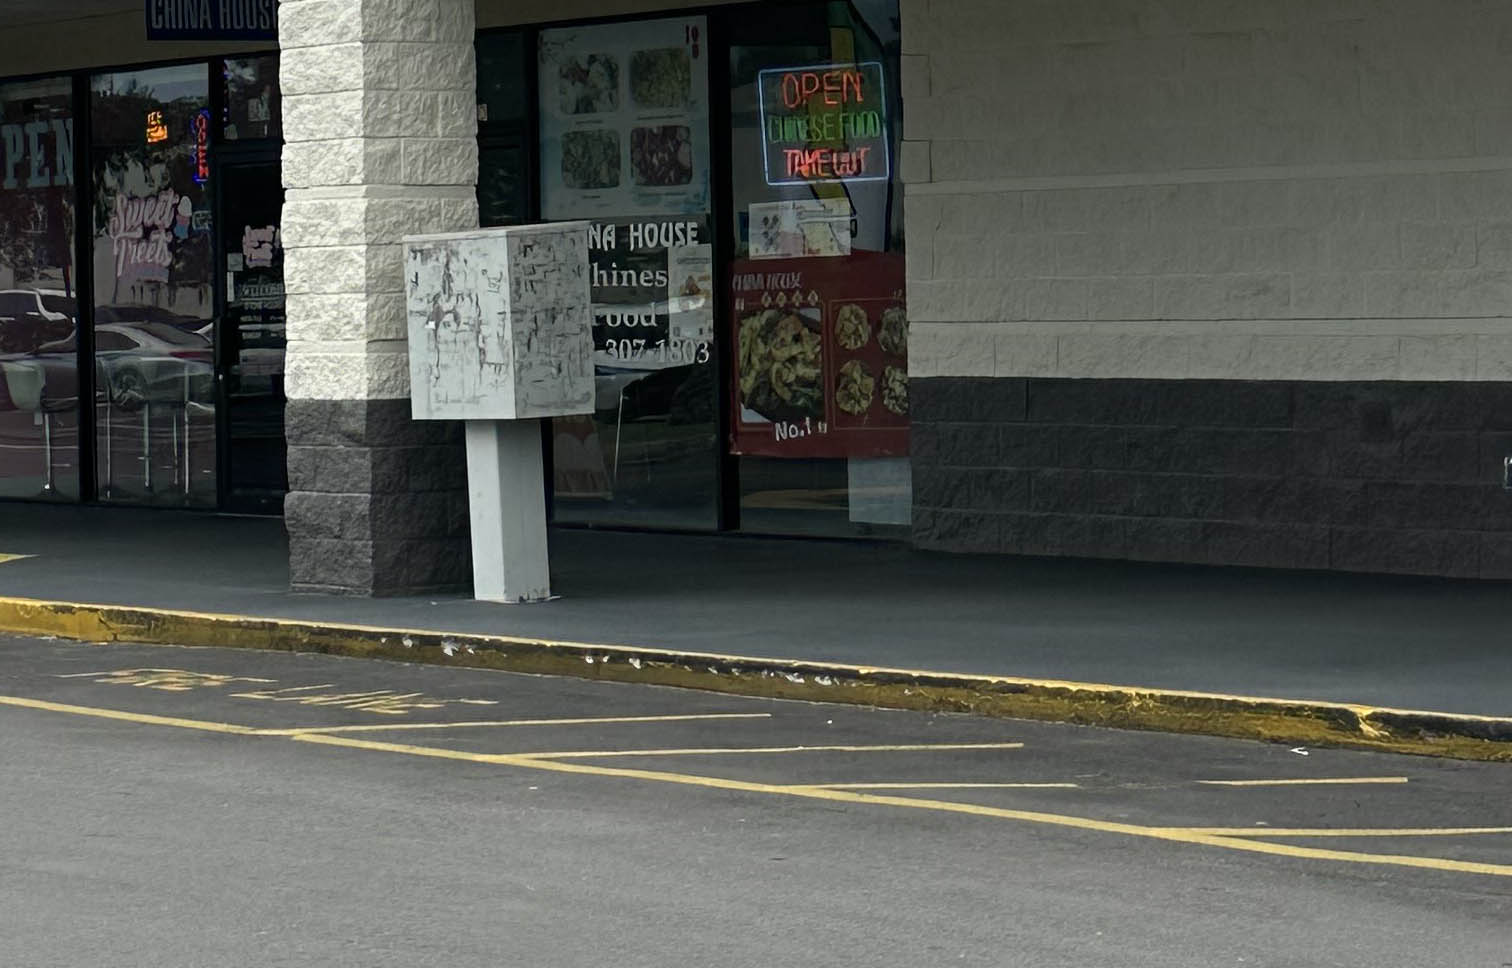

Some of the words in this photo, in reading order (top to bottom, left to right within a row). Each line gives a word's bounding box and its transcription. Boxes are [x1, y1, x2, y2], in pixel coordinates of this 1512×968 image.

[783, 71, 865, 108] OPEN
[839, 110, 881, 141] FOOD
[109, 187, 179, 240] Sweet
[629, 221, 699, 252] HOUSE
[591, 261, 668, 288] hines
